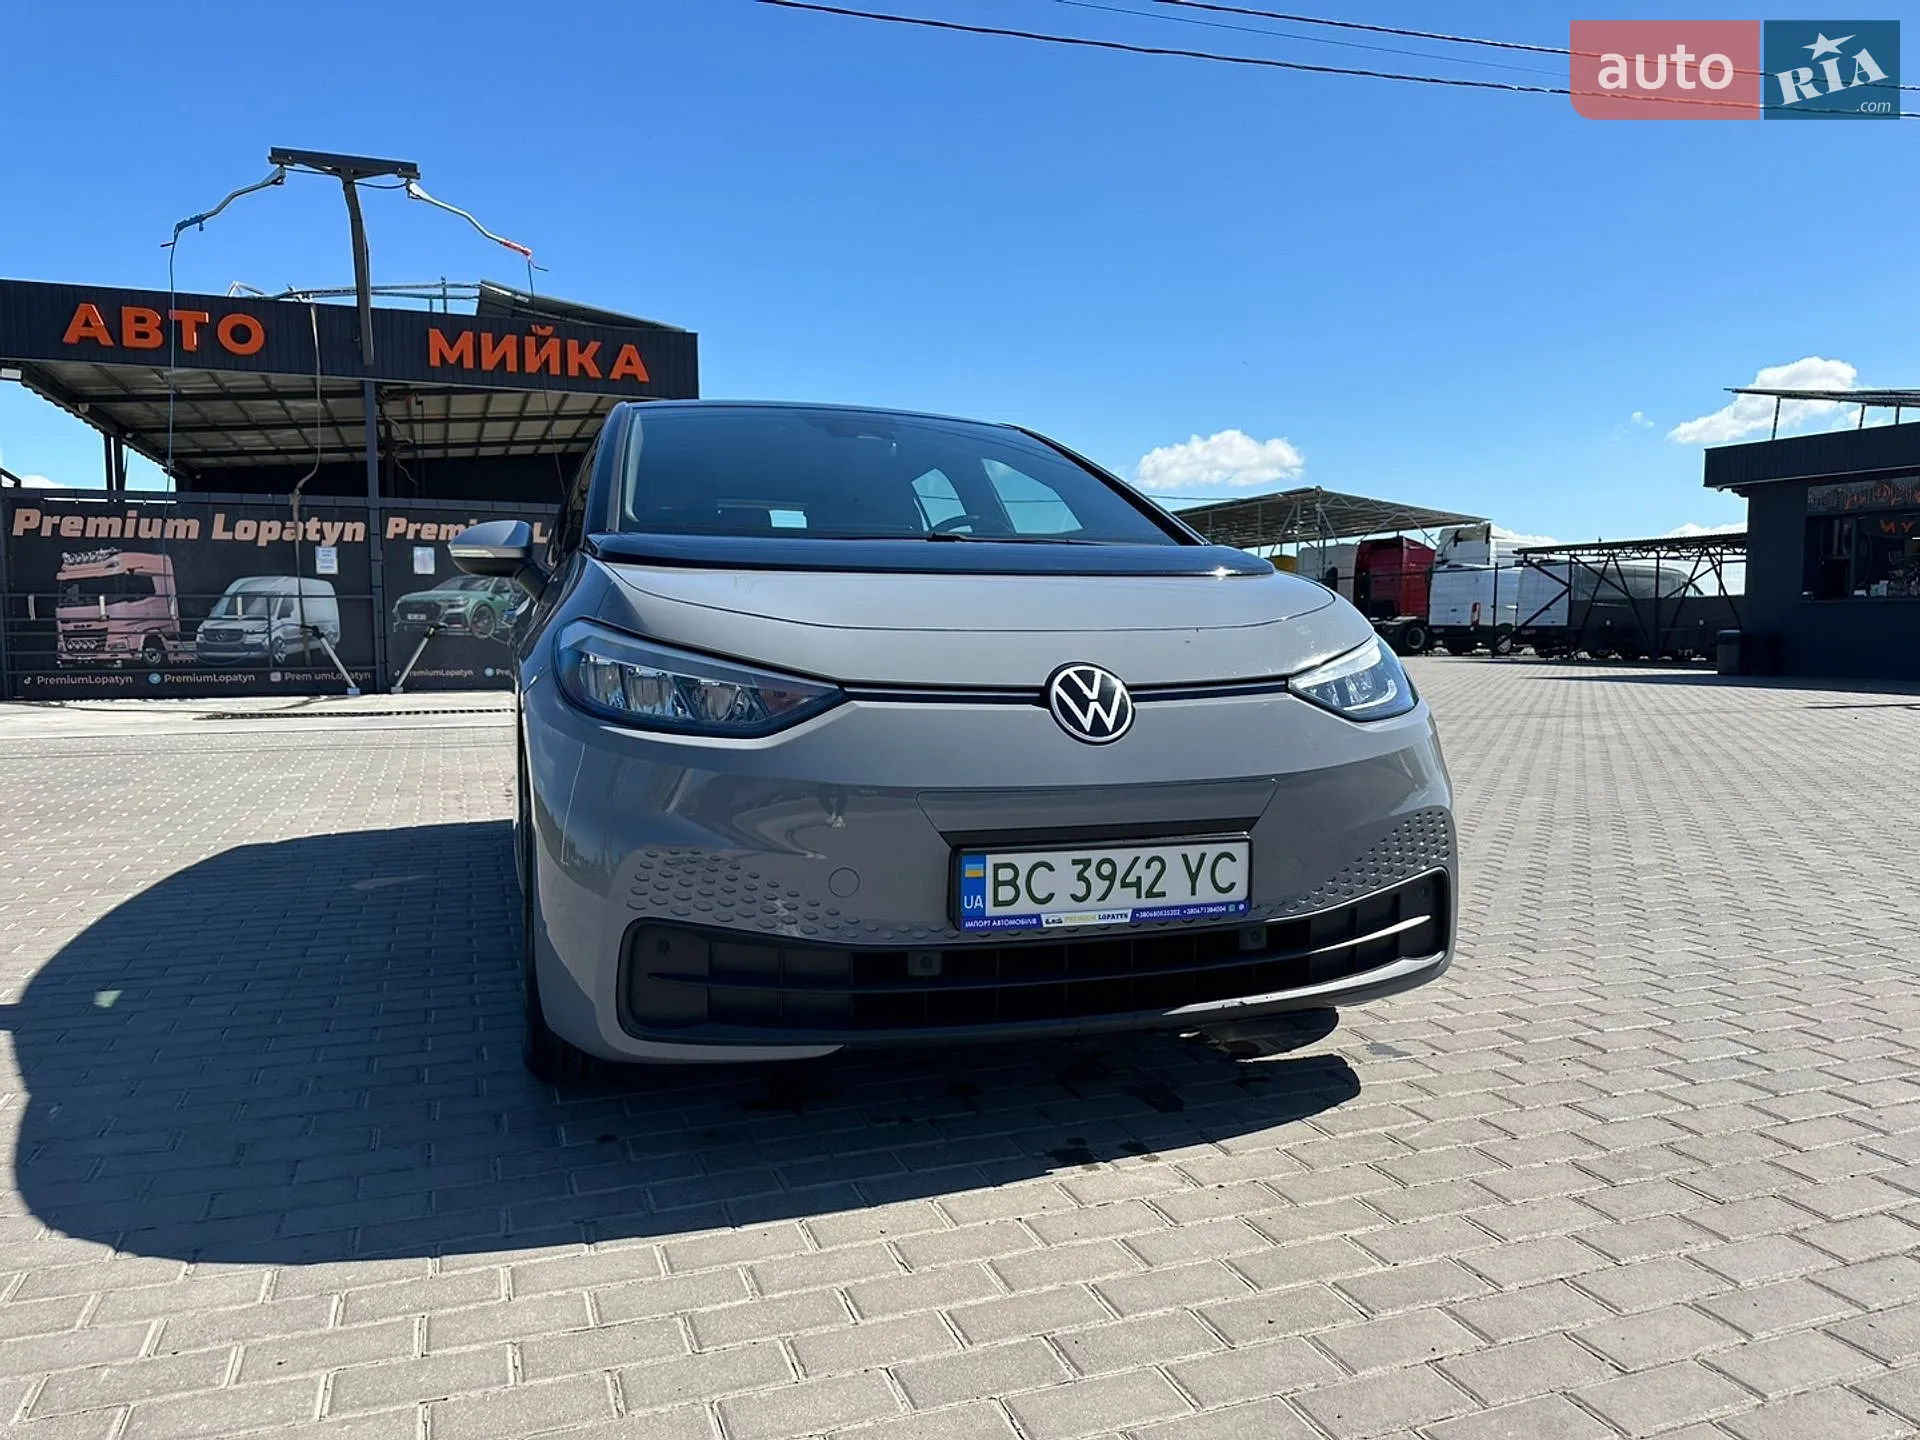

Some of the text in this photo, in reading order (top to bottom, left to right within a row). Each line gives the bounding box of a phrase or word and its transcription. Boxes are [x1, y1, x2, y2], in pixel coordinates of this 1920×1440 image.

[62, 302, 650, 383] АВТО МИЙКА
[11, 508, 366, 547] Premium Lopatyn
[37, 674, 133, 686] PremiumLopatyn
[164, 673, 255, 684] PremiumLopatyn
[993, 851, 1237, 907] BC 3942 YC
[964, 896, 984, 909] UA
